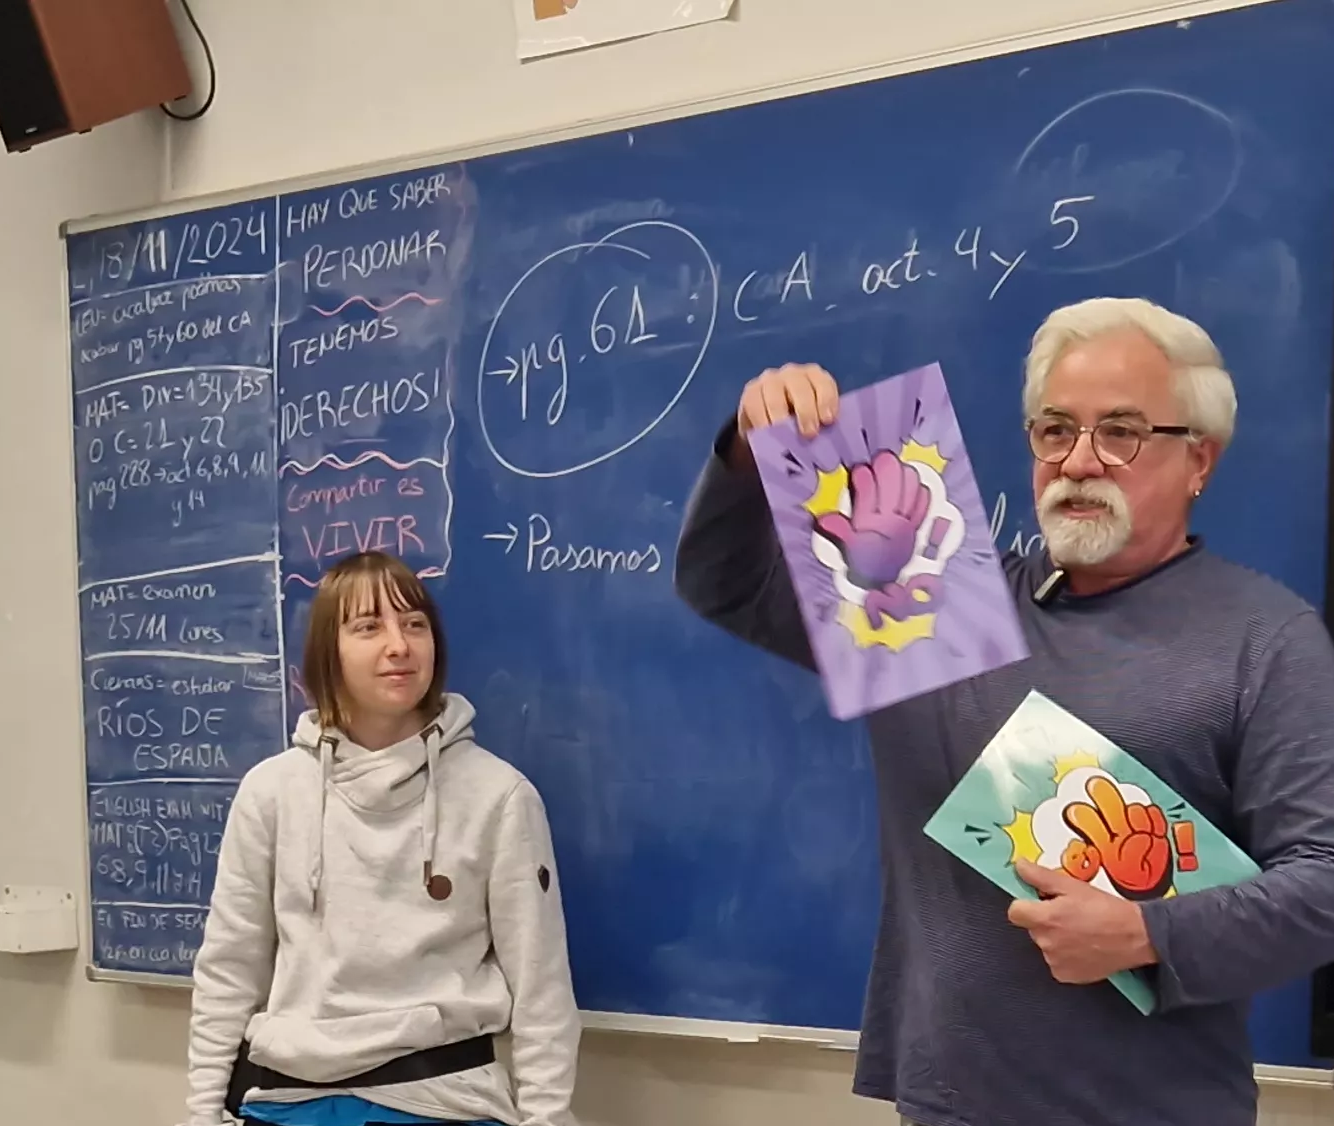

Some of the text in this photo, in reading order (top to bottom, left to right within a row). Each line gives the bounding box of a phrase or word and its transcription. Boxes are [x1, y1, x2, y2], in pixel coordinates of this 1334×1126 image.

[286, 172, 451, 239] HAY QUE SABER
[1049, 195, 1096, 250] 5
[303, 229, 447, 294] PERDONAR
[288, 315, 399, 369] TENEMOS
[285, 472, 424, 515] Compartir es
[301, 514, 425, 560] VIVIR
[526, 512, 662, 574] Pasamos
[142, 583, 218, 601] examen
[171, 676, 235, 696] estudiar
[96, 697, 227, 738] RÍOS DE
[133, 742, 230, 772] ESPAÑA
